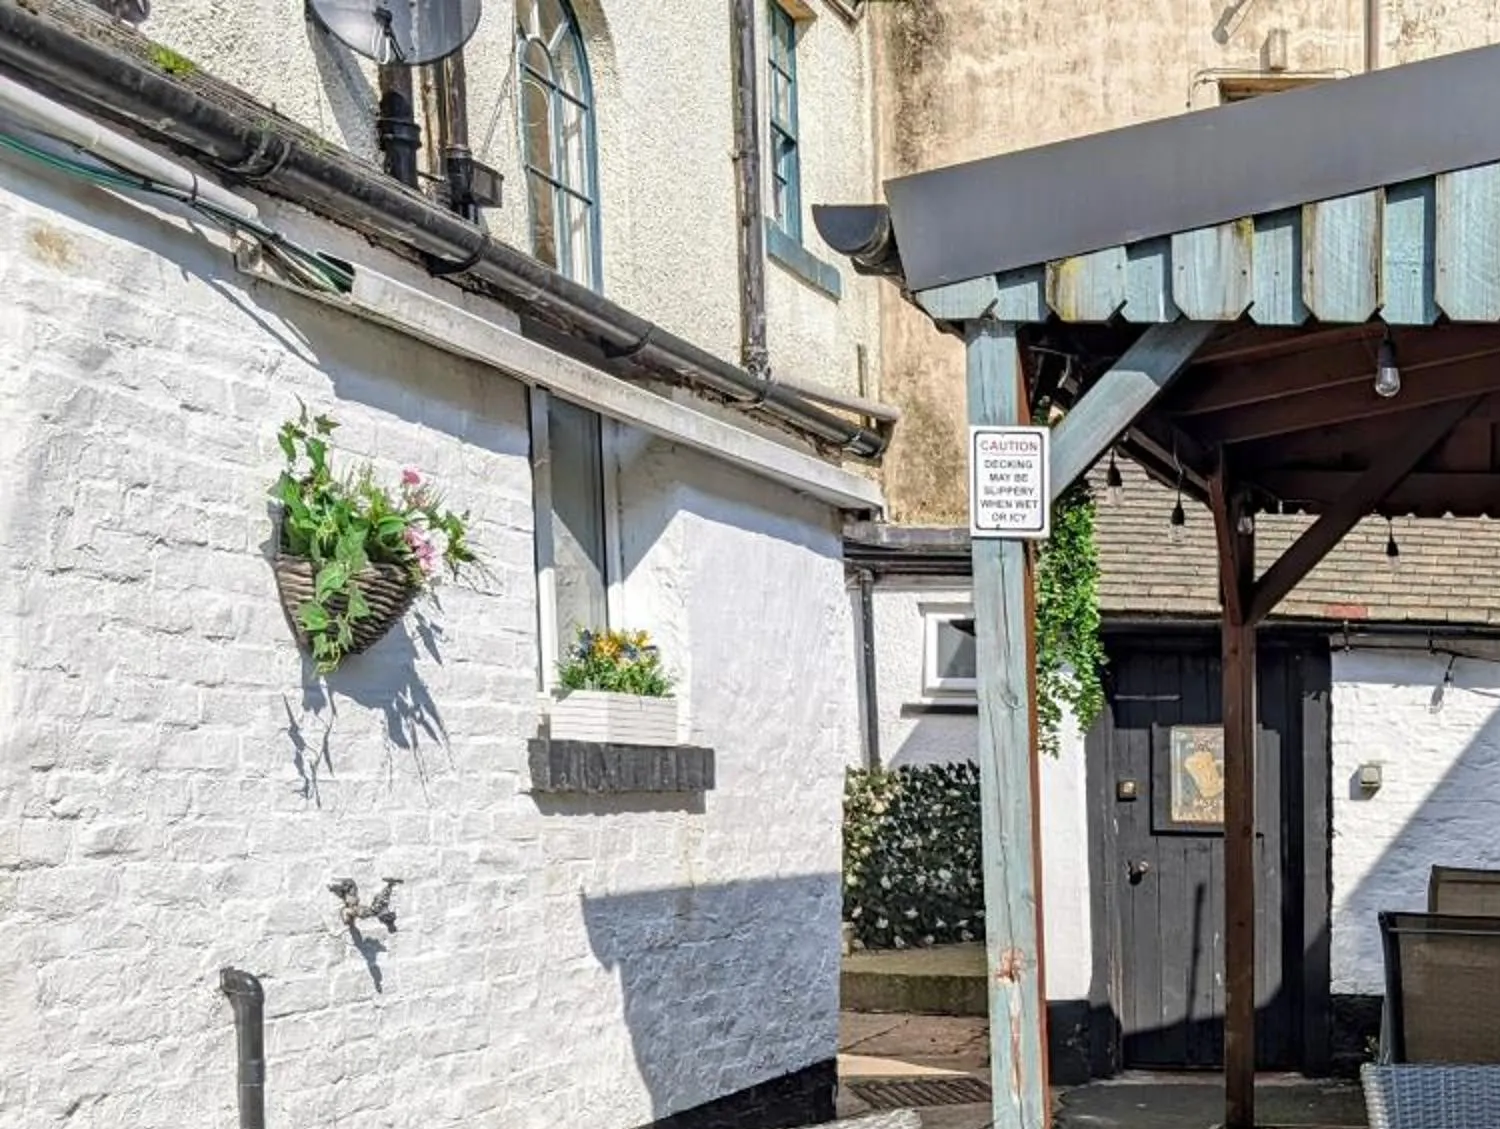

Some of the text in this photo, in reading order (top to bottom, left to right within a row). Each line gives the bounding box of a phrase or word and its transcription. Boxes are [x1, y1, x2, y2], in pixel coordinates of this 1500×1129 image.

[980, 440, 1038, 451] CAUTION
[984, 459, 1033, 469] DECKING
[989, 473, 1029, 482] MAY BE
[984, 486, 1034, 496] SLIPPERY
[981, 500, 1038, 509] WHEN WET
[991, 513, 1027, 522] OR ICY
